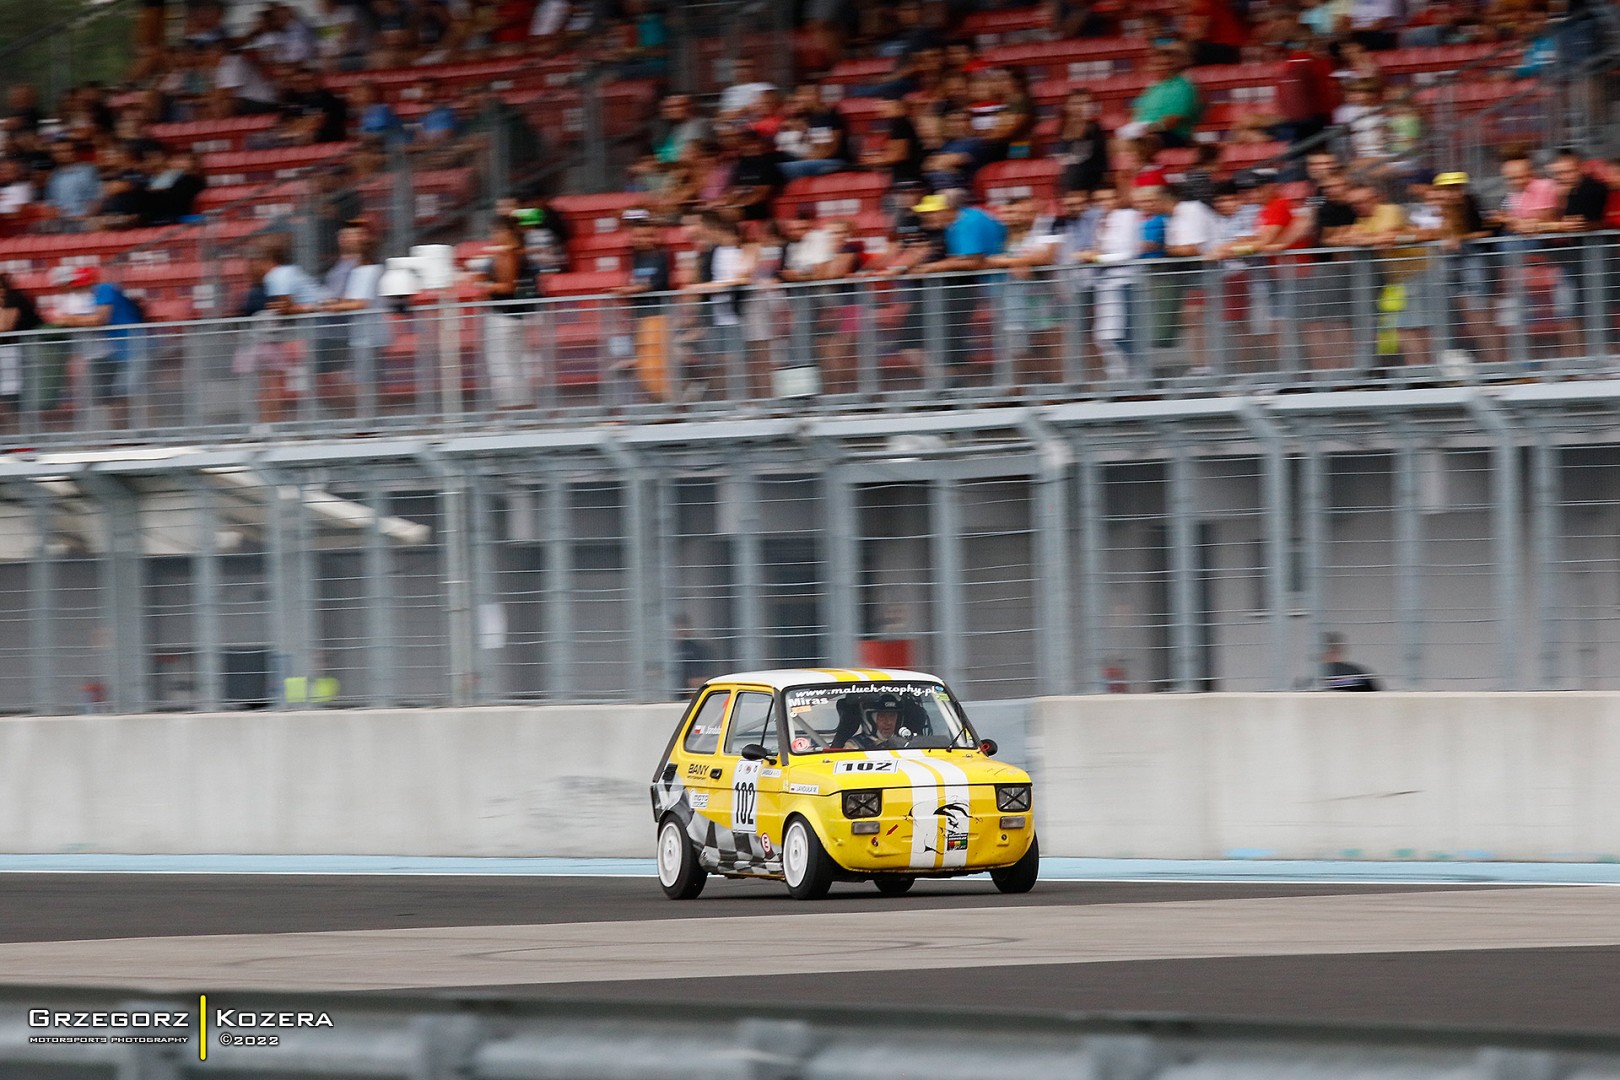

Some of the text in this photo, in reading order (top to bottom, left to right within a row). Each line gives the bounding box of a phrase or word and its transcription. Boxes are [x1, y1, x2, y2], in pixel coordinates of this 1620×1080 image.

[789, 697, 828, 707] Miras
[688, 764, 709, 776] BANY
[842, 762, 892, 772] 102
[734, 782, 756, 825] 102
